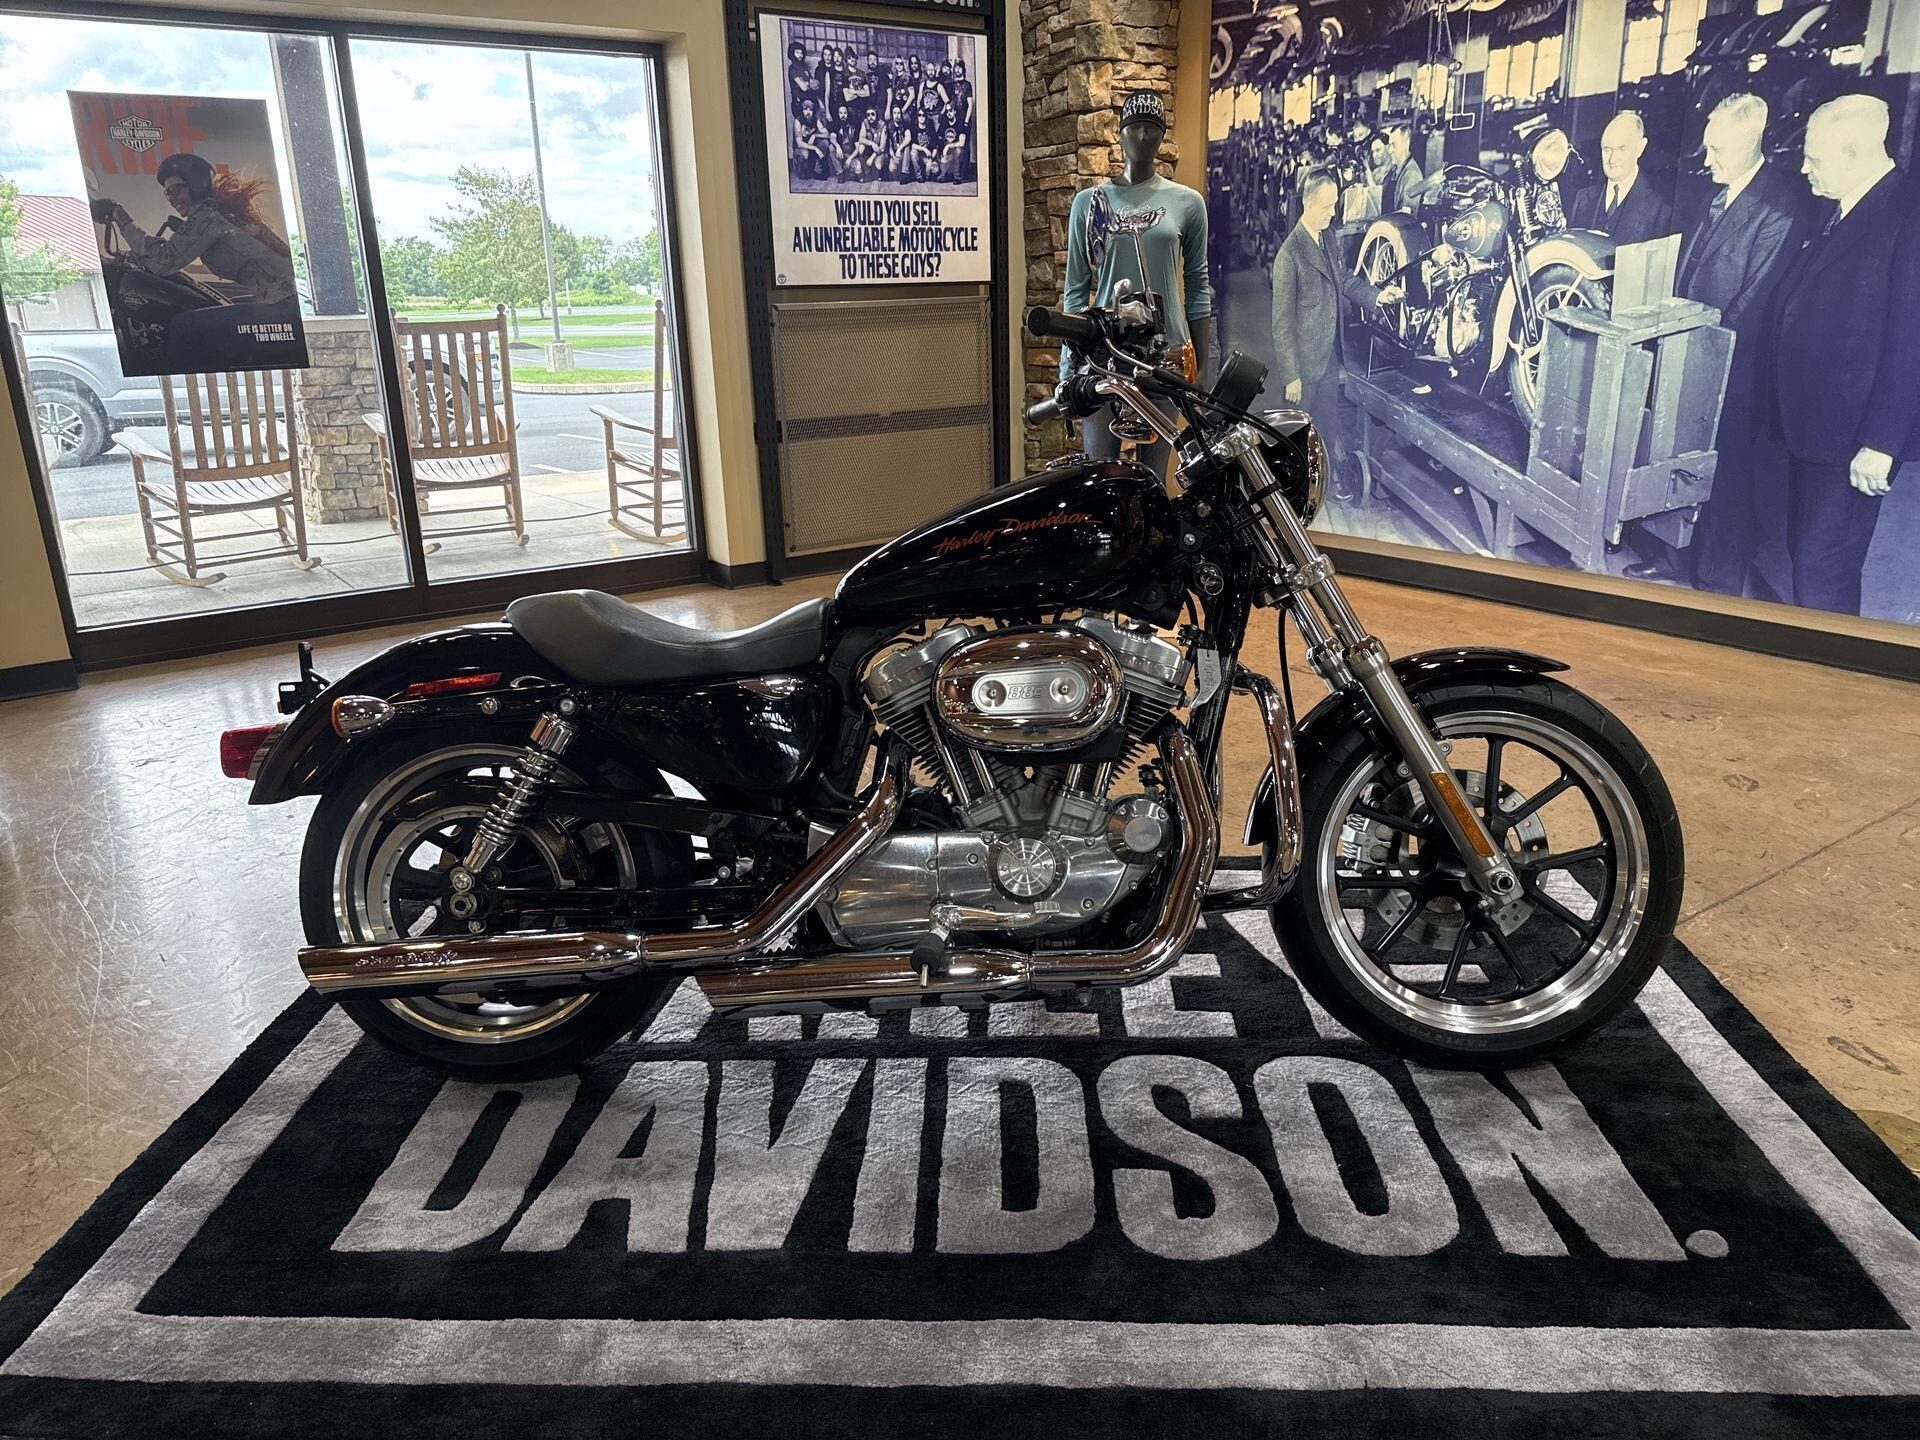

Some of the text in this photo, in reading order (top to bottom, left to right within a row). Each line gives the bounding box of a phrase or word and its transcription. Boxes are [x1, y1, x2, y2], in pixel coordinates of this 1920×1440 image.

[125, 139, 152, 149] CYCLES
[834, 199, 942, 226] WOULD YOU SELL
[792, 226, 978, 253] AN UNRELIABLE MOTORCYCLE
[839, 252, 942, 279] TO THESE GUYS?
[237, 323, 293, 334] LIFE IS BETTER ON
[255, 332, 296, 342] TWO WHEELS.
